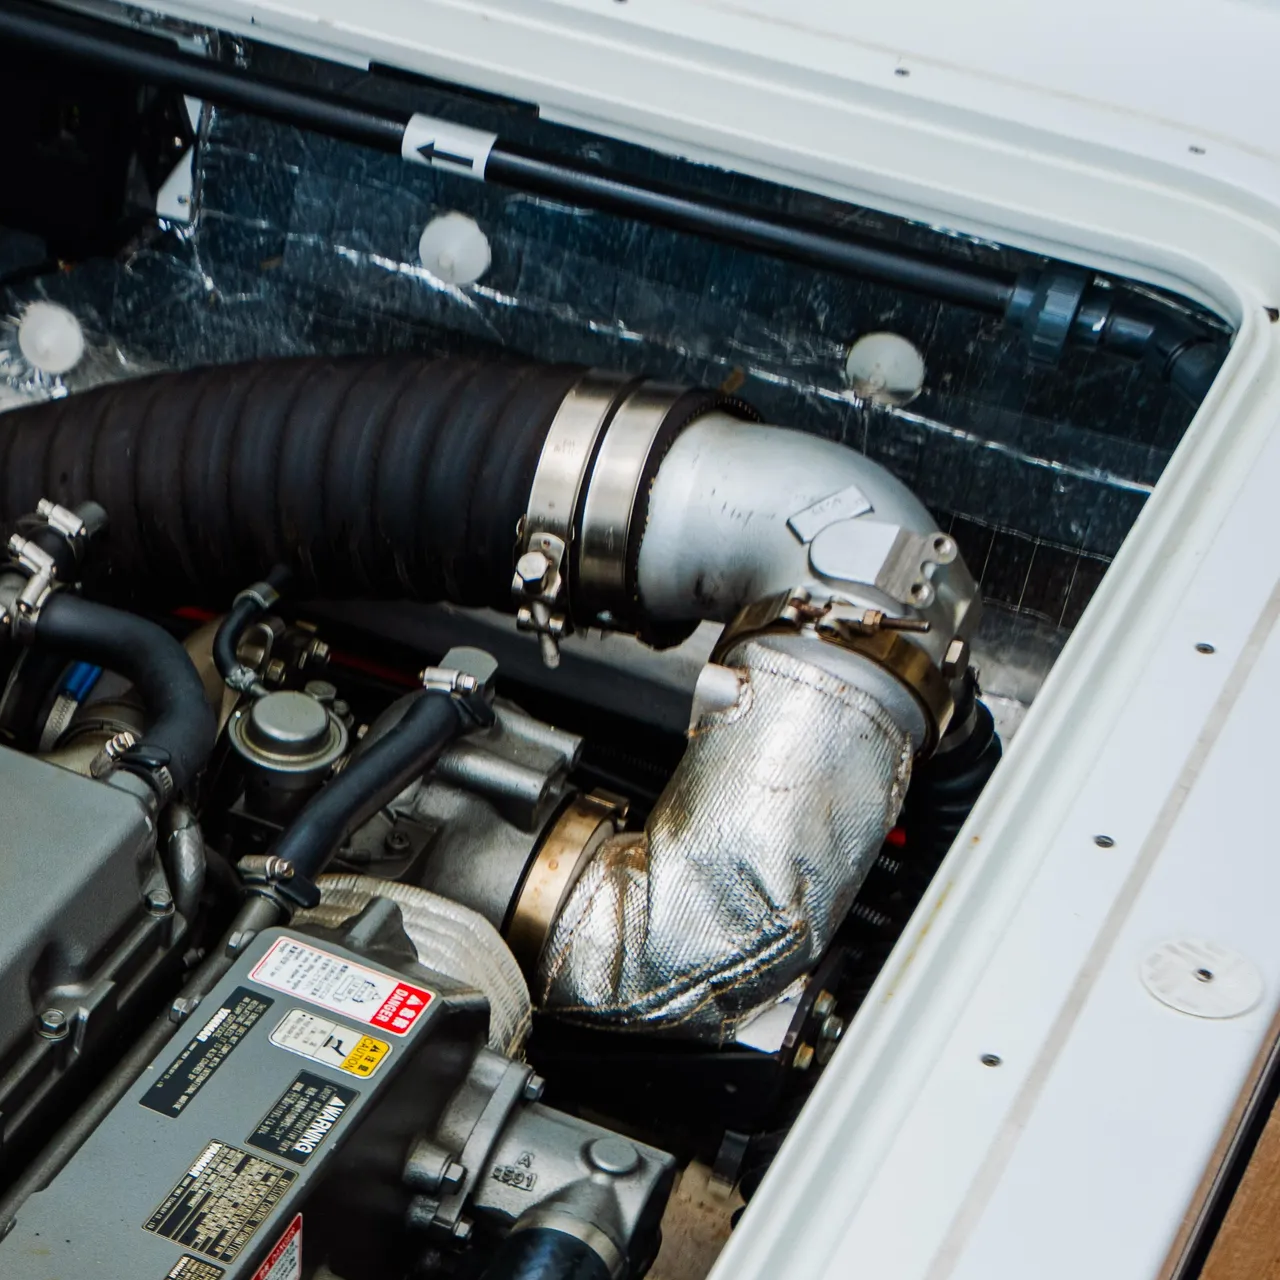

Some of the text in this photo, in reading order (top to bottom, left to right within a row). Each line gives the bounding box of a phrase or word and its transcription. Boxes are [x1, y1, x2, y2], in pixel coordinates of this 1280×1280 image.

[377, 989, 407, 1021] DANGER
[196, 1007, 231, 1042] YANMAR
[344, 1037, 373, 1069] CAUTION
[295, 1106, 340, 1152] WARNING
[188, 1142, 223, 1178] YANMAR
[225, 1178, 289, 1255] EMISSION CONTROL INFORMATION
[169, 1257, 188, 1278] YANMAR
